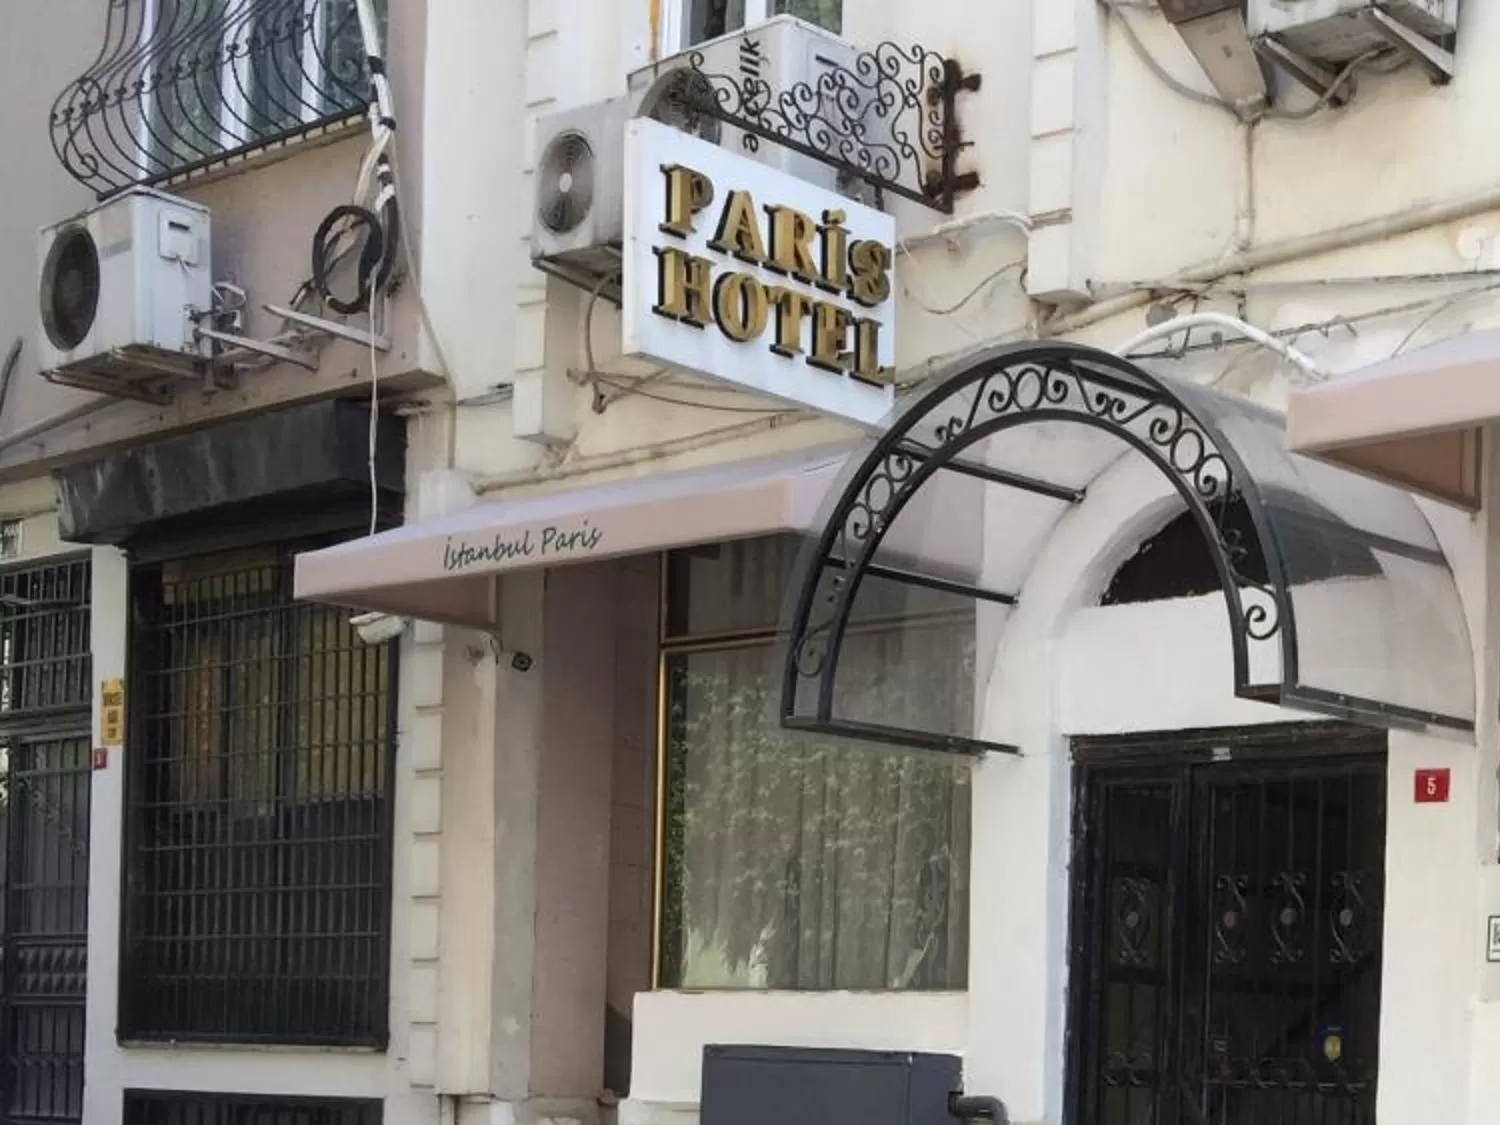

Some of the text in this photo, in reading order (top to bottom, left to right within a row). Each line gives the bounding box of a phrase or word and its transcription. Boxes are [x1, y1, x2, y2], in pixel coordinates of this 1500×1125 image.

[740, 37, 760, 153] açelik
[651, 245, 896, 389] HOTEL
[541, 519, 603, 554] Paris
[1427, 777, 1437, 795] 5
